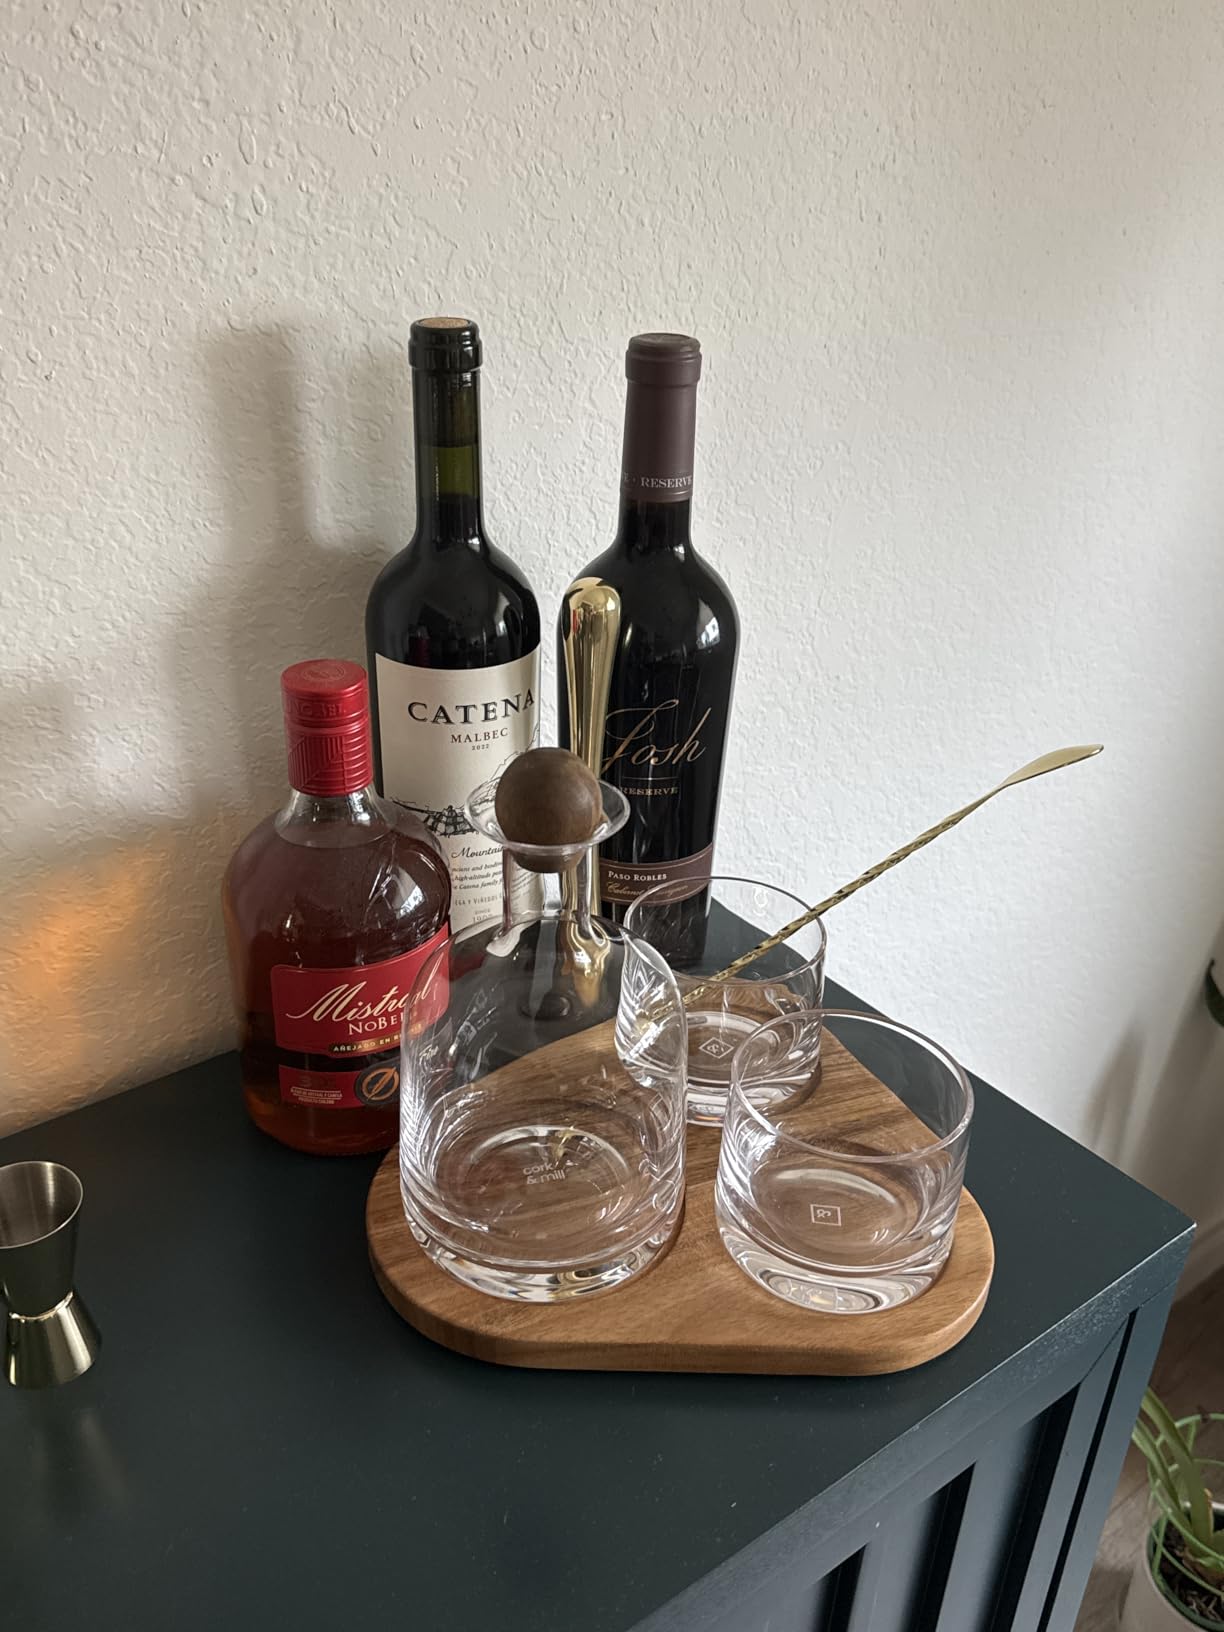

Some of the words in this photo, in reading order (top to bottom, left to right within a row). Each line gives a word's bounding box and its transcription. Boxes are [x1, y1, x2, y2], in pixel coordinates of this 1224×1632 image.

[407, 688, 535, 725] CATENA
[450, 727, 508, 744] MALBEC
[621, 786, 678, 796] RESERVE
[608, 870, 631, 880] PASO
[634, 873, 667, 881] ROBLES
[333, 1041, 376, 1052] AÑEJADO
[380, 1037, 391, 1046] EN
[523, 1162, 554, 1175] cork
[540, 1169, 566, 1183] mill
